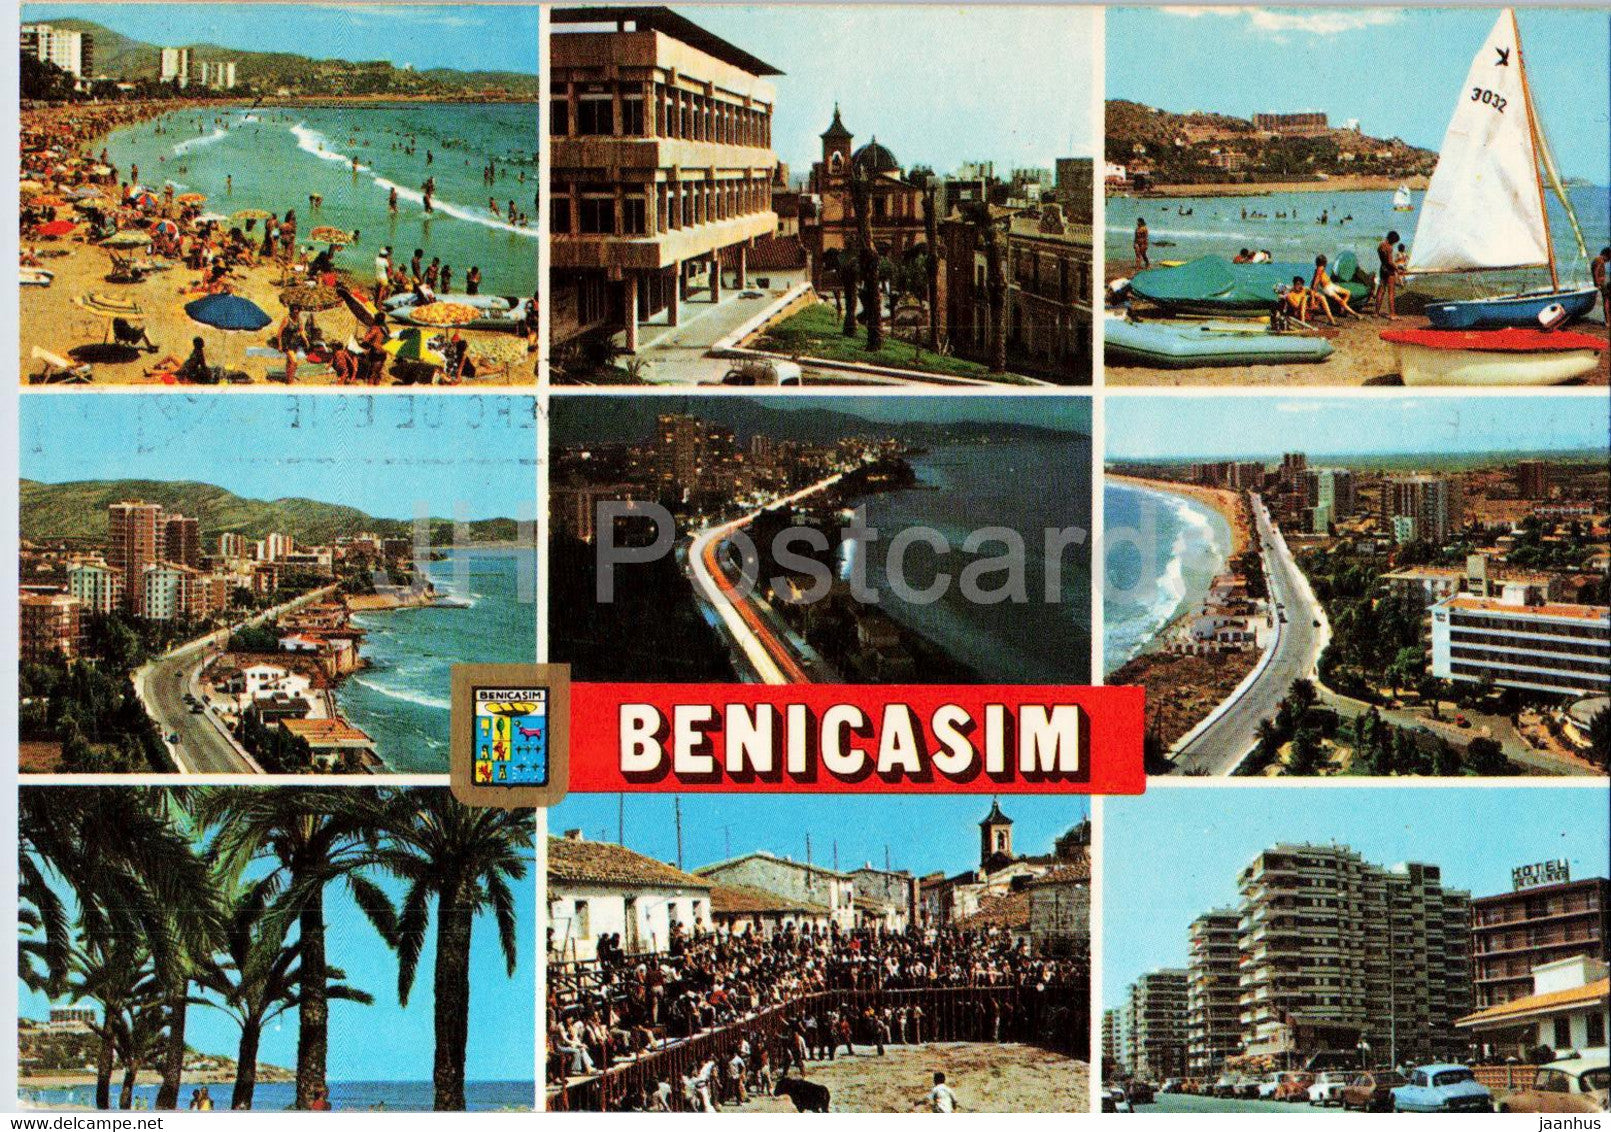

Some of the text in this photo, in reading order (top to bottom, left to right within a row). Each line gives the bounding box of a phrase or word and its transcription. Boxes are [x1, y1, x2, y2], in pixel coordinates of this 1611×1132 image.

[1471, 87, 1507, 114] 3032
[479, 691, 542, 700] BENICASIM
[619, 703, 1091, 784] BENICASIM
[1511, 858, 1564, 878] HOTEL
